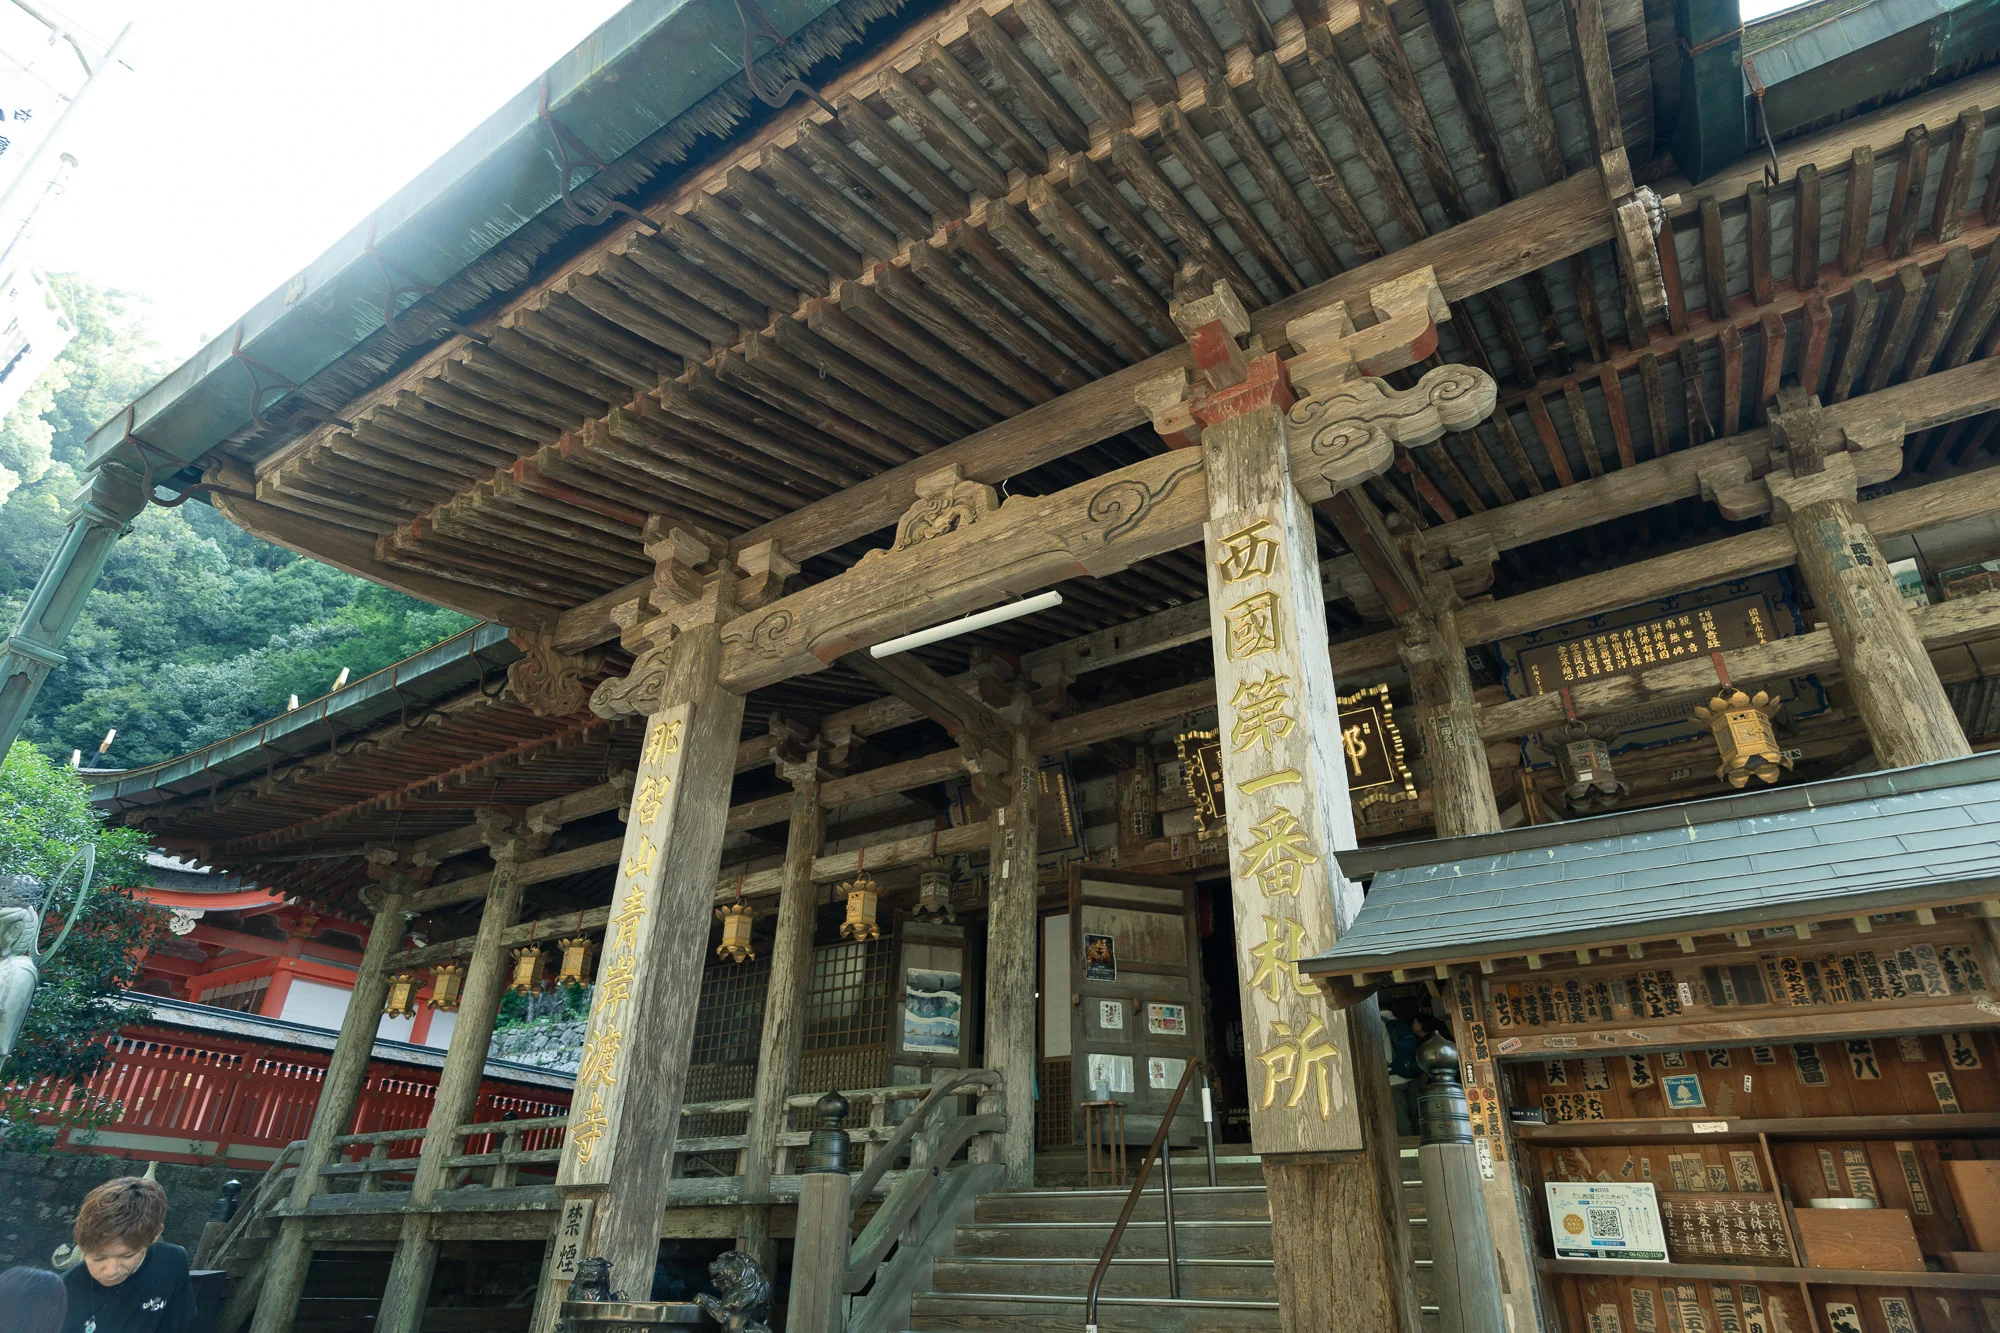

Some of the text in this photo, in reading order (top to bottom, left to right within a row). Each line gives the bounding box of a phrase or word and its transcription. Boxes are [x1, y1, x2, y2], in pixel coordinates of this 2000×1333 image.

[1213, 518, 1339, 1123] 西國第一番札所
[571, 718, 683, 1165] 那智山青岸渡寺
[557, 1203, 584, 1274] 禁煙
[1679, 1203, 1699, 1254] その他祈願
[1694, 1199, 1717, 1255] 安産祈願
[1729, 1200, 1752, 1255] 交通安全
[1748, 1200, 1771, 1256] 身体健全
[1764, 1201, 1790, 1257] 家内安全
